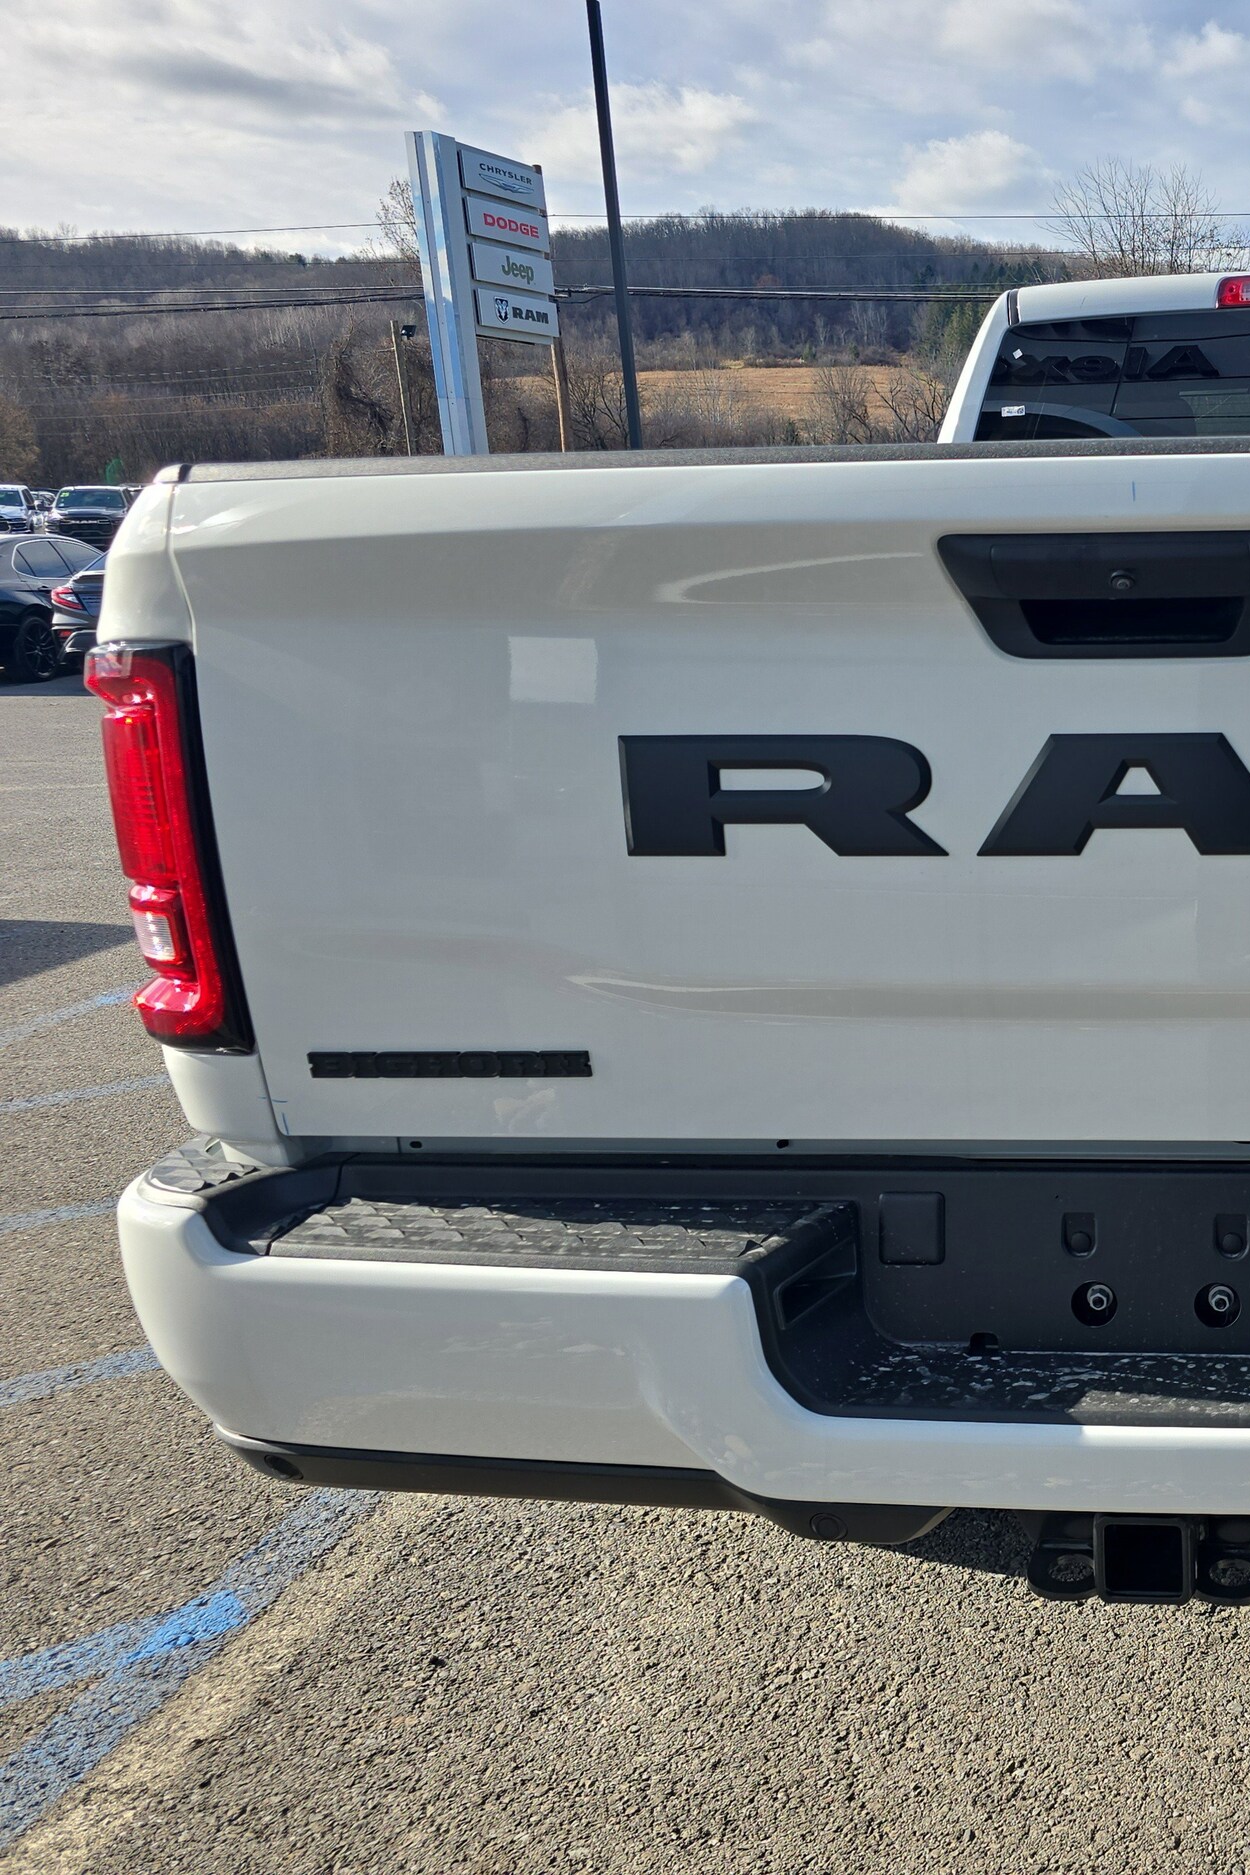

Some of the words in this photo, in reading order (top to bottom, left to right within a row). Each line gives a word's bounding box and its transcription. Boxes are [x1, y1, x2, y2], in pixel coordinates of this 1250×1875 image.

[479, 163, 533, 185] CHRYSLER
[483, 213, 540, 239] DODGE
[501, 255, 535, 285] Jeep
[511, 306, 550, 324] RAM
